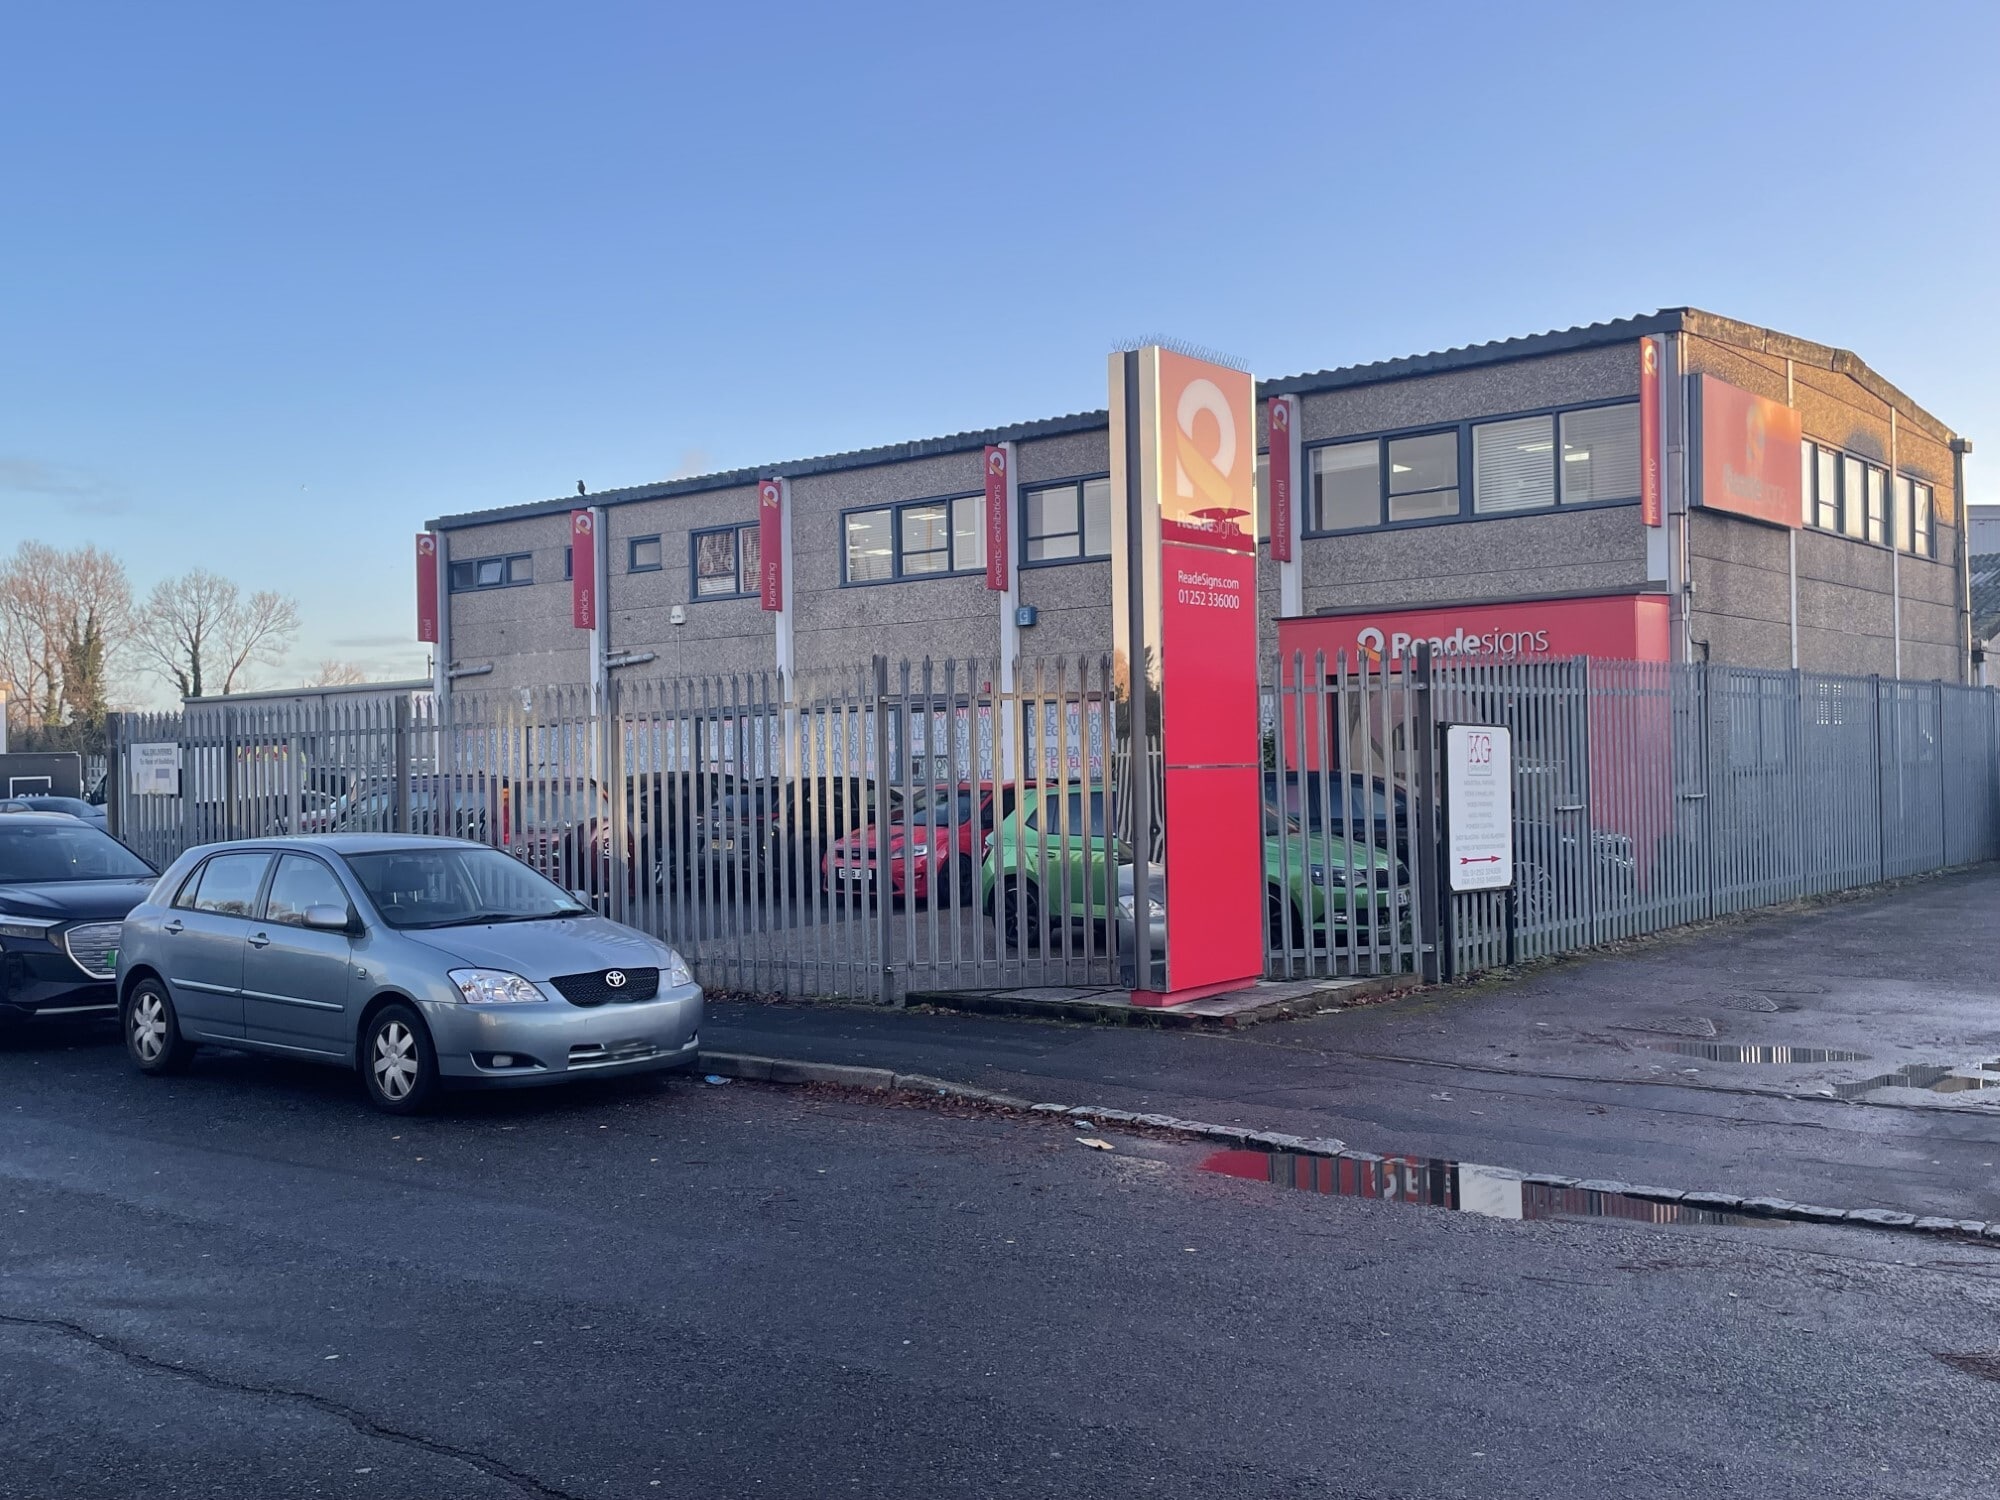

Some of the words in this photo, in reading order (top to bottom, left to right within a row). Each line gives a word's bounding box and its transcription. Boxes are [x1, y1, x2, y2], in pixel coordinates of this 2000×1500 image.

[1649, 458, 1659, 520] property
[993, 484, 1002, 542] exhibitions
[1177, 509, 1240, 540] Readesigns
[1276, 479, 1286, 556] architectural
[768, 562, 778, 607] branding
[1177, 569, 1240, 590] ReadeSigns.com
[580, 589, 590, 626] vehicles
[1178, 589, 1206, 606] 01252
[1208, 592, 1240, 609] 336000
[423, 618, 433, 640] retail
[1469, 735, 1492, 763] KG
